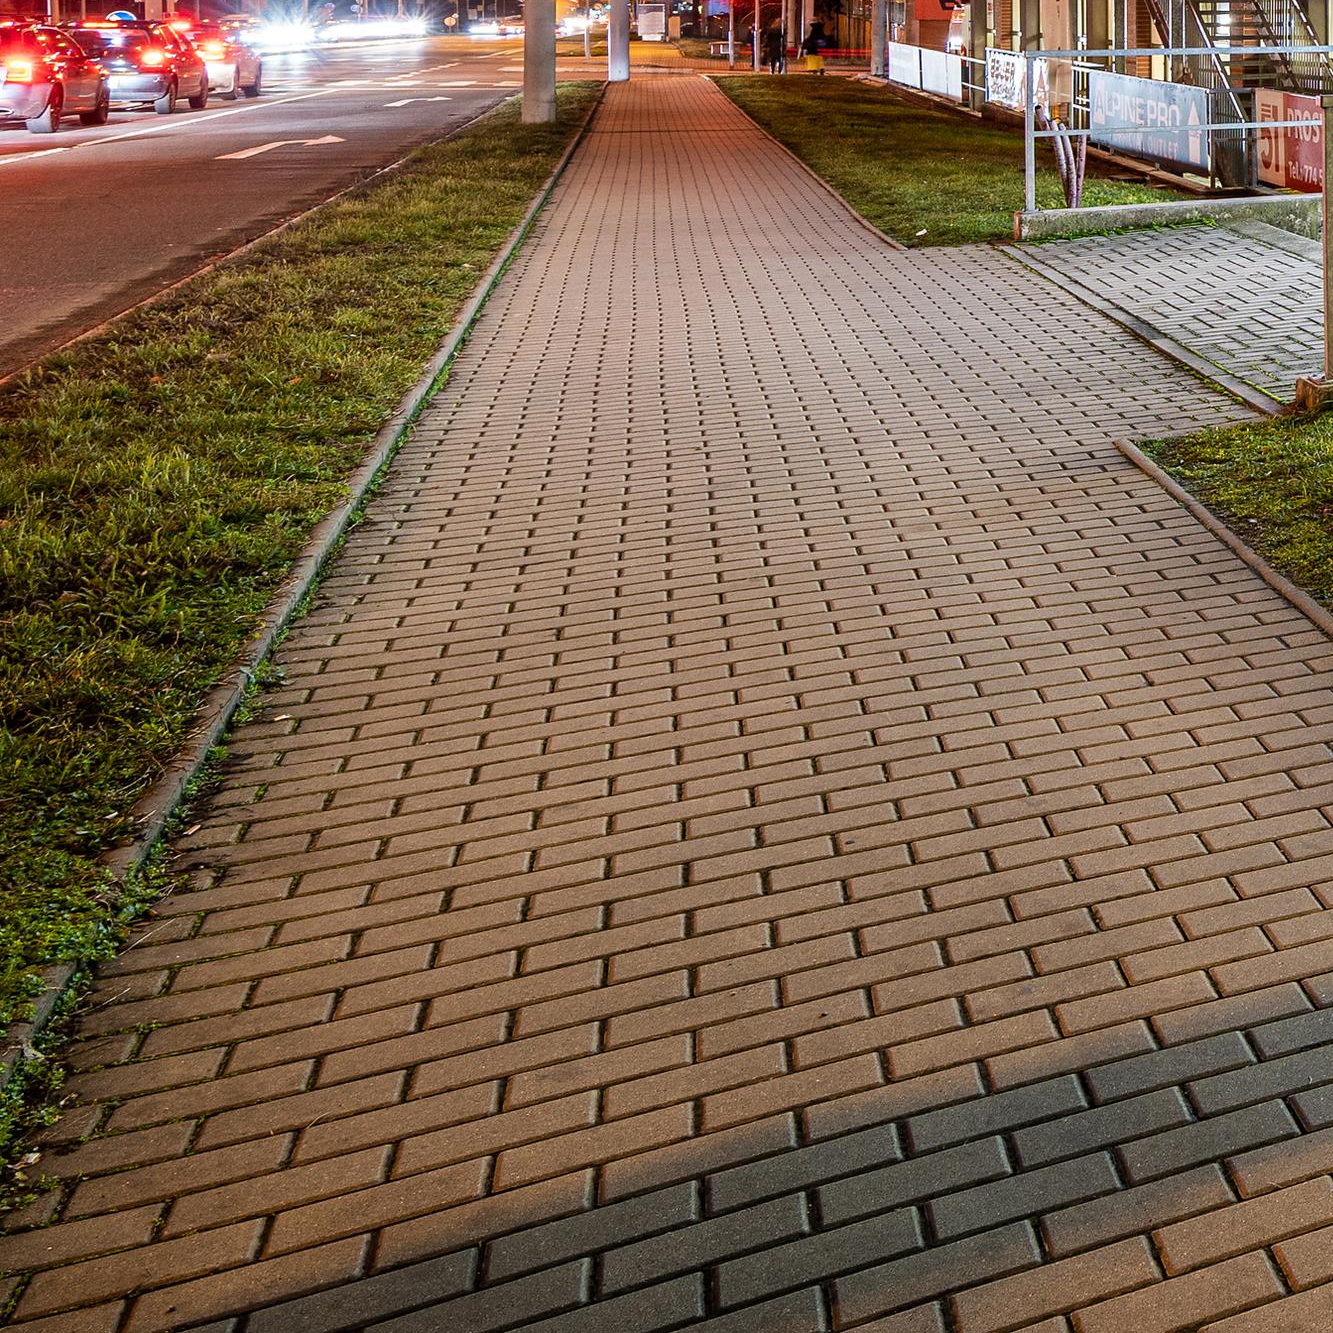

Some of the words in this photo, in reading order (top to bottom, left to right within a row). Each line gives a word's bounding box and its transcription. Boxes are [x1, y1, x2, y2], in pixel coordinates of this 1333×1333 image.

[1093, 79, 1145, 126] ALPINE
[1146, 99, 1181, 134] PRO
[1304, 165, 1317, 185] 774
